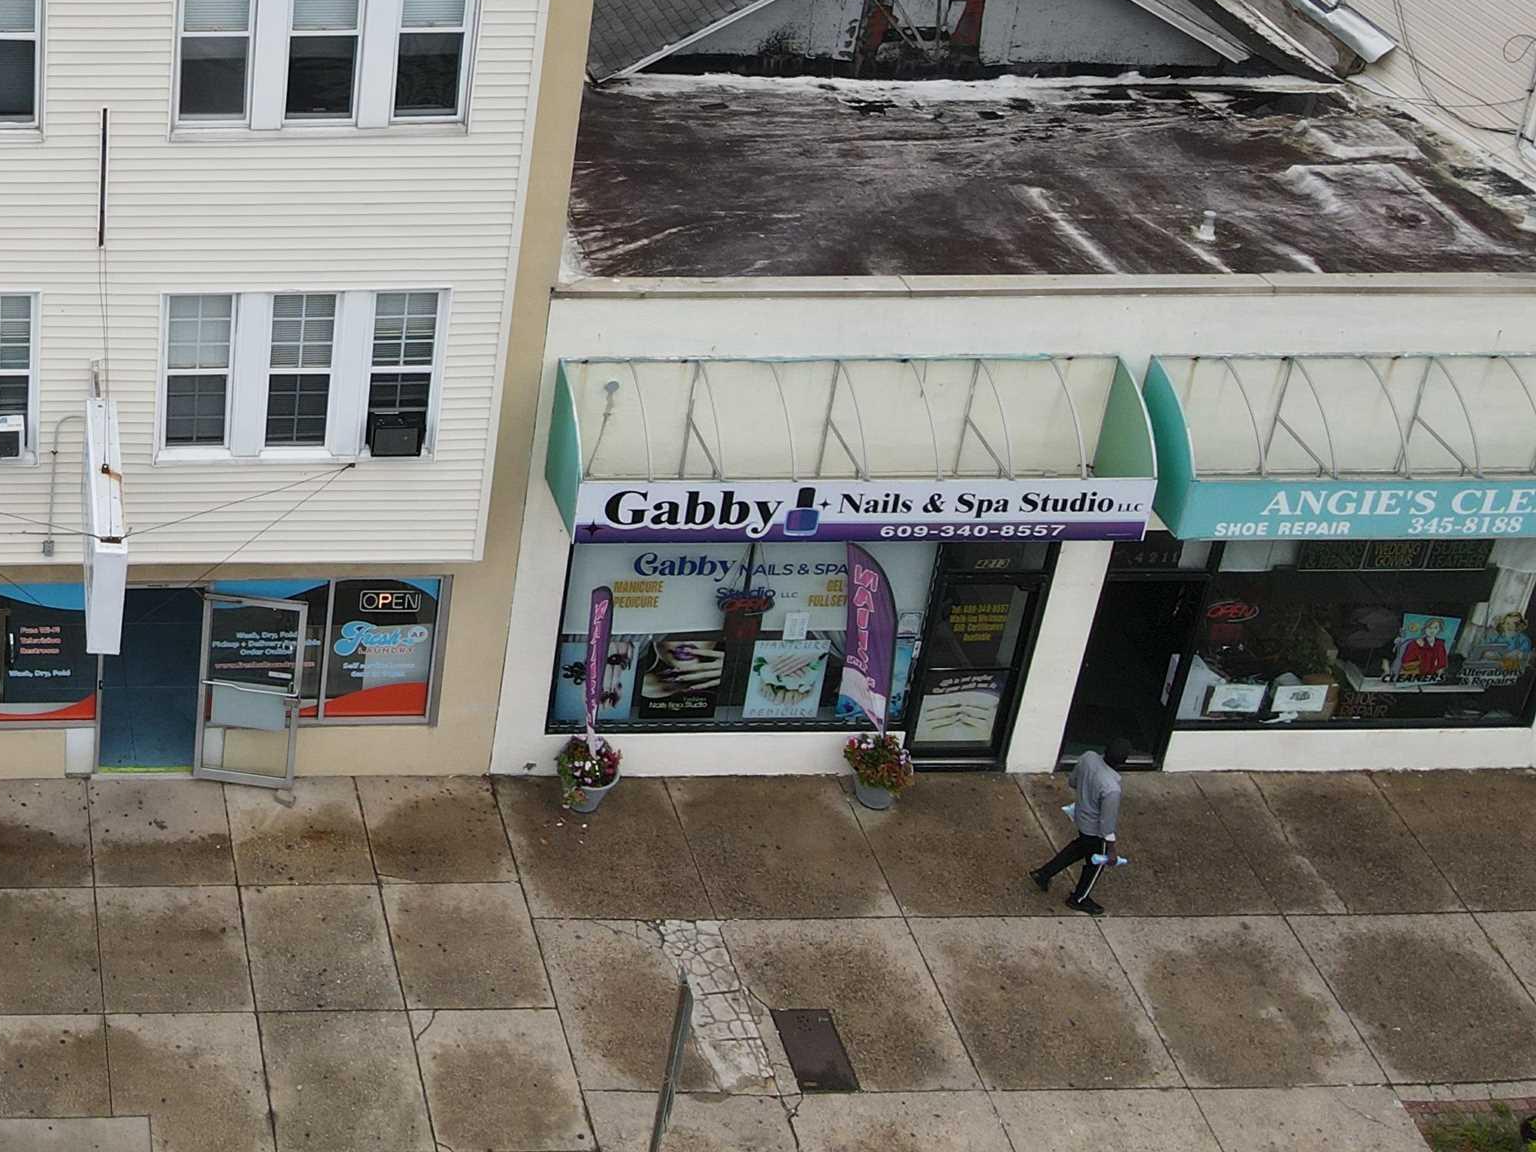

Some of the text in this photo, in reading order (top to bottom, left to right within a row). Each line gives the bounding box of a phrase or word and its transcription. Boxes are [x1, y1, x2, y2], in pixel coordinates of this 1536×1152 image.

[838, 491, 1144, 518] Nails & Spa Studio LLC
[1261, 490, 1437, 515] ANGIE'S
[605, 490, 784, 534] Gabby
[879, 525, 1067, 537] 609-340-8557
[1214, 522, 1351, 536] SHOE REPAIR
[1408, 517, 1523, 534] 345-8188
[634, 552, 738, 582] Gabby
[739, 563, 848, 576] NAILS & SPA
[615, 580, 664, 593] MANICURE
[363, 593, 420, 609] OPEN
[615, 596, 659, 608] PEDICURE
[1208, 604, 1255, 617] OPEN
[334, 621, 402, 656] Fresh
